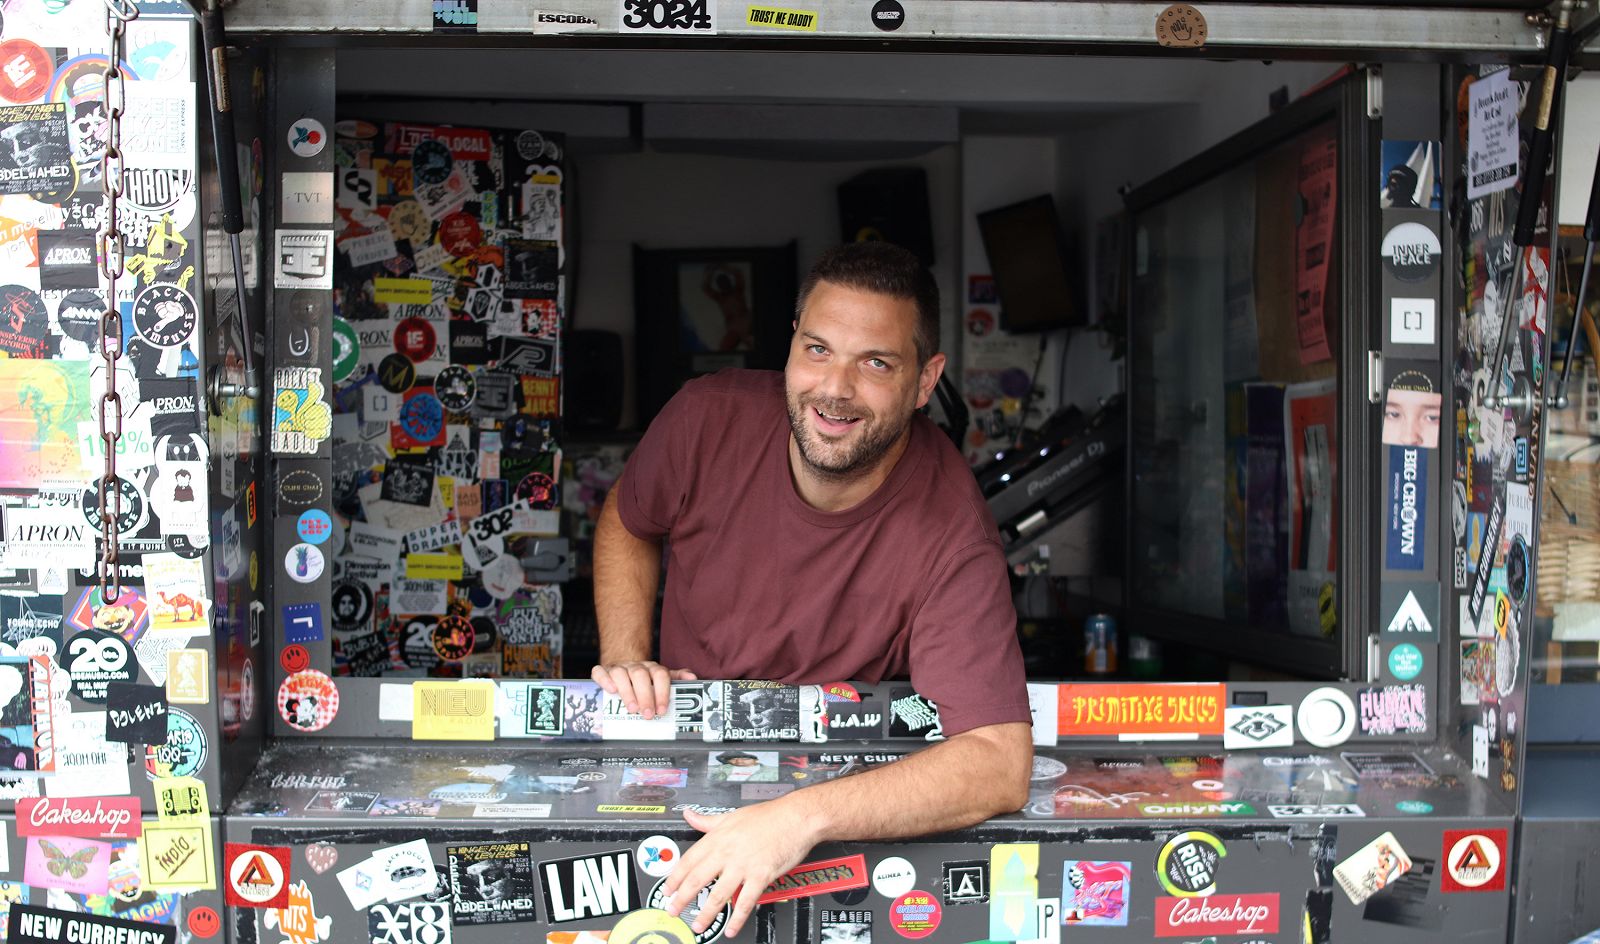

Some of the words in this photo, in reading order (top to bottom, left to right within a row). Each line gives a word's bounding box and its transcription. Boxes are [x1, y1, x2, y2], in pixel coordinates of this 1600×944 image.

[622, 0, 712, 29] 3024
[749, 9, 774, 23] TRUST
[775, 12, 787, 24] ME
[787, 13, 814, 27] DADDY
[0, 166, 70, 181] BDELWAHED
[294, 192, 322, 204] TVT
[1392, 243, 1430, 256] INNER
[1392, 253, 1432, 266] PEACE
[137, 288, 184, 316] BLACK
[142, 312, 194, 345] IMPULSE
[276, 369, 319, 388] ROCKET
[273, 434, 316, 451] RADIO
[1026, 454, 1085, 497] Pioneer
[1087, 441, 1105, 457] DJ
[1403, 449, 1417, 482] BIG
[1508, 492, 1531, 509] PUBLIC
[474, 506, 516, 540] 302
[1400, 482, 1418, 556] CROWN
[1508, 519, 1529, 536] ORDER
[12, 525, 85, 541] APRON
[409, 522, 458, 542] SUPER
[1479, 499, 1502, 581] CURRENCY
[412, 533, 460, 553] DRAMA
[344, 560, 391, 570] Dimension
[7, 617, 34, 629] YOUNG
[37, 619, 60, 629] ECHO
[509, 616, 542, 625] SOME
[512, 608, 538, 618] PUT
[501, 623, 550, 636] WEIGHT
[510, 634, 526, 643] ON
[529, 634, 543, 643] IT
[69, 637, 128, 672] 20
[77, 682, 93, 691] REAL
[420, 689, 487, 717] NEU
[724, 683, 732, 730] DEENA
[1360, 690, 1423, 718] HUMAN
[109, 701, 166, 729] DOLENZ
[725, 728, 799, 739] ABDELWAHED
[819, 753, 858, 763] NEW
[30, 798, 131, 833] Cakeshop
[385, 852, 400, 872] BLACK
[402, 850, 425, 864] FOCUS
[1177, 843, 1211, 889] RISE
[448, 855, 462, 903] DEENA
[545, 853, 629, 922] LAW
[454, 898, 533, 913] ABDELWAHED
[1169, 898, 1270, 932] Cakeshop
[20, 912, 63, 940] NEW
[66, 920, 165, 944] CURRENCY
[283, 905, 308, 932] NTS
